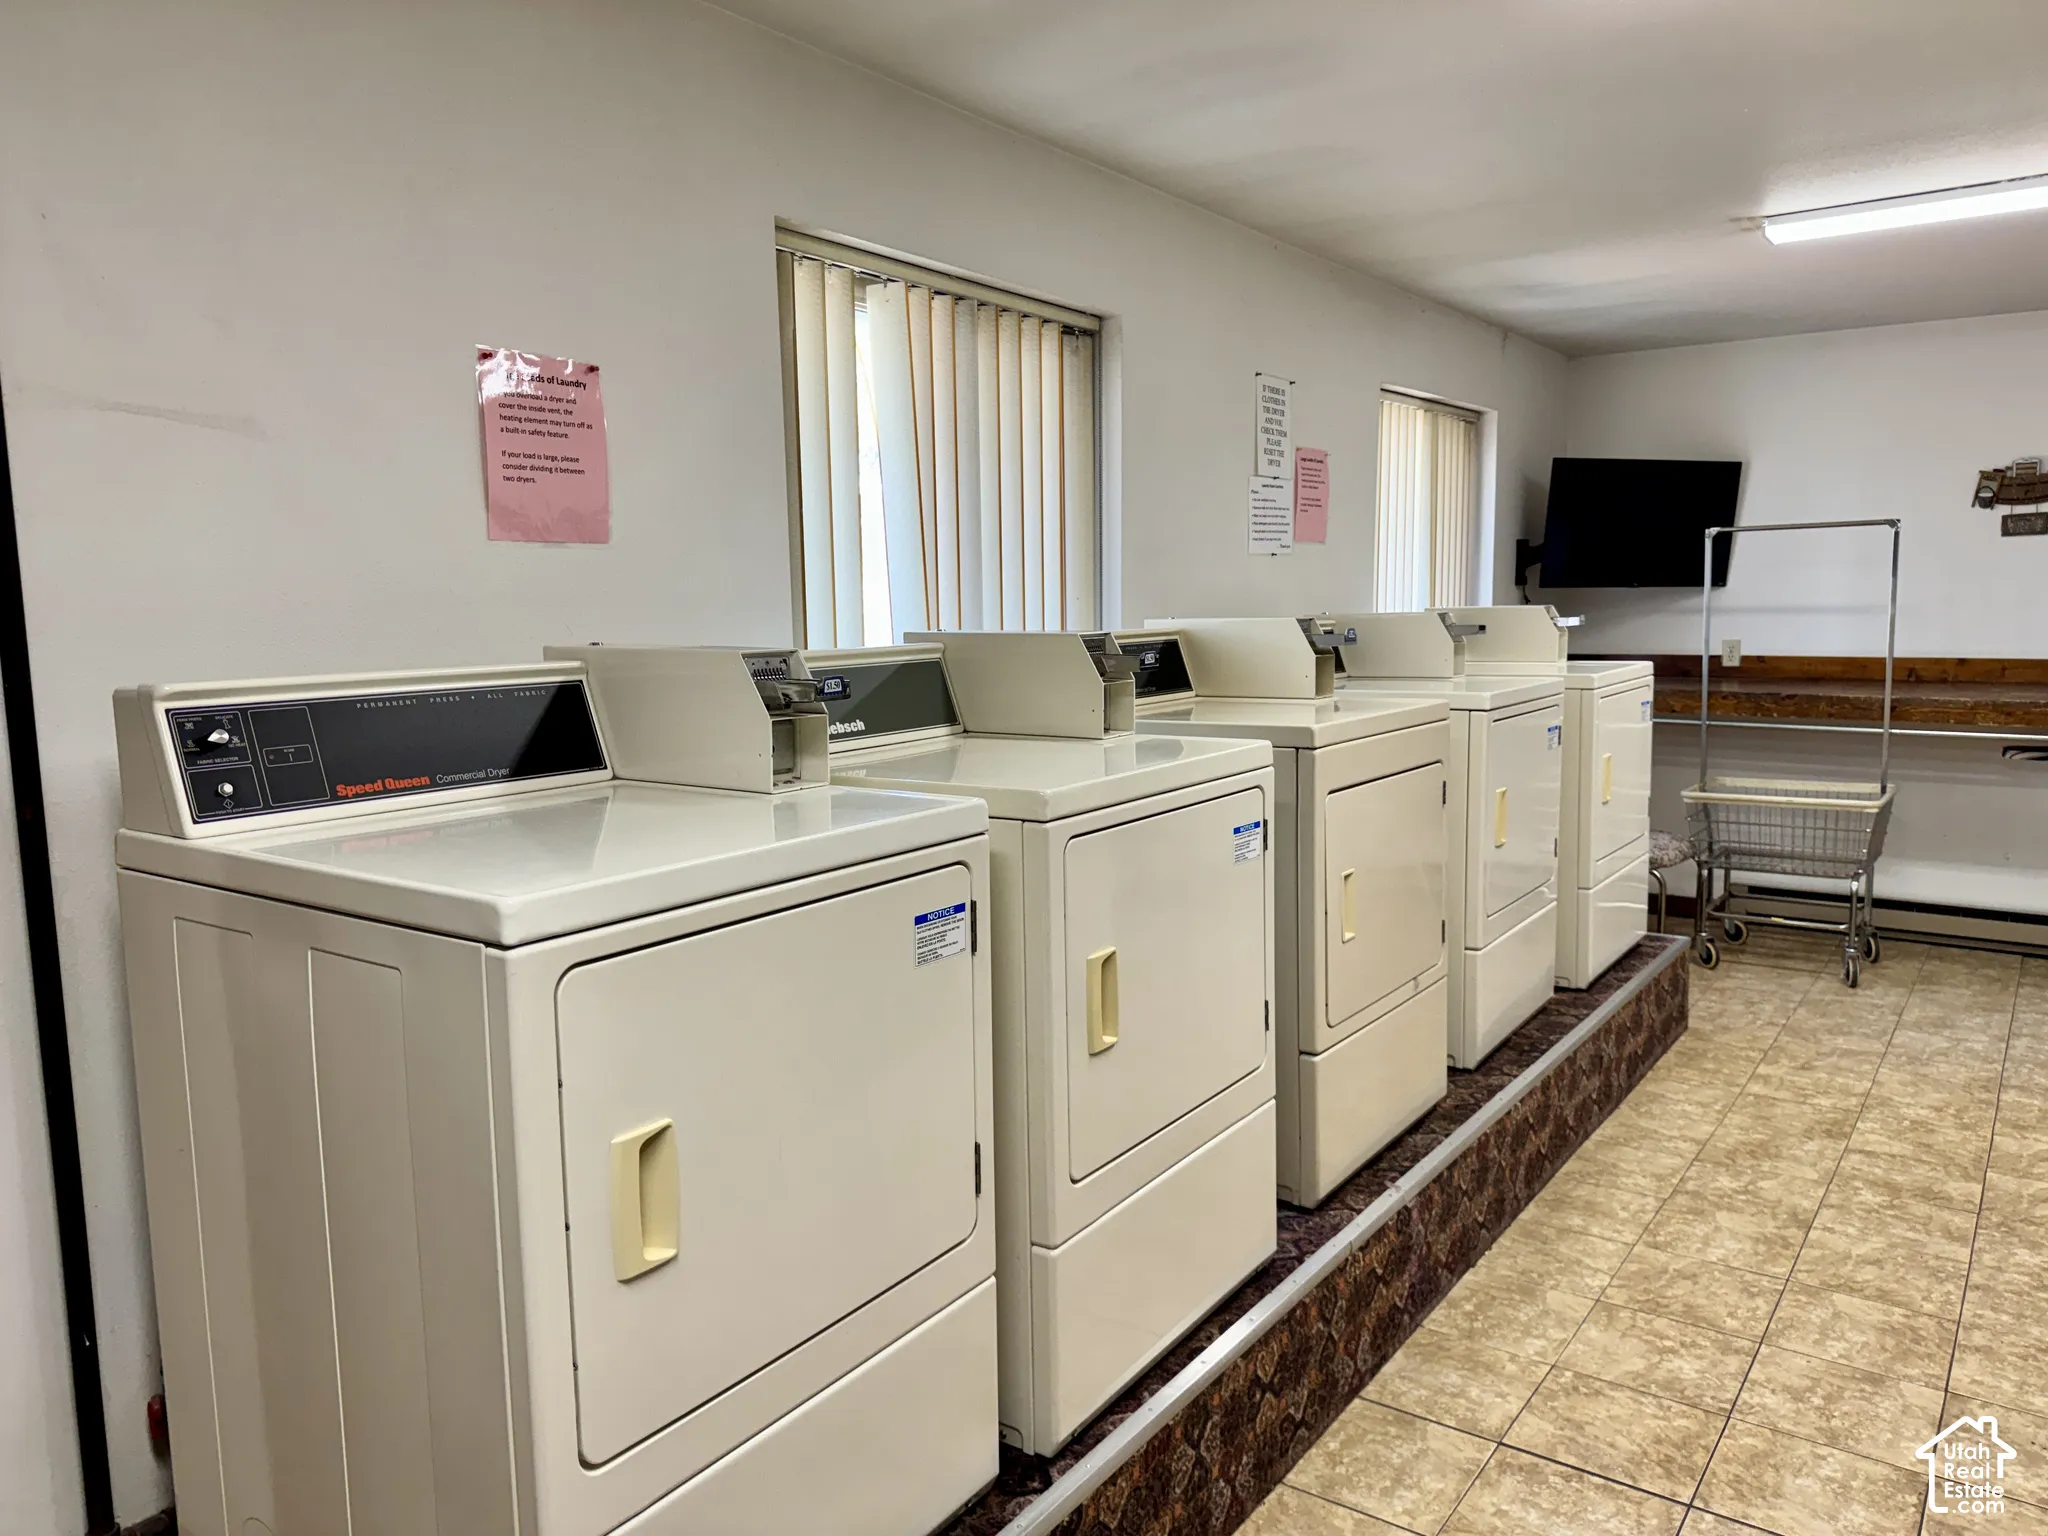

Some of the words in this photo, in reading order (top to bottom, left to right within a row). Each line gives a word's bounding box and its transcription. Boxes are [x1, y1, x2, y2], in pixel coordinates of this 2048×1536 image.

[547, 375, 555, 384] of
[556, 377, 587, 390] Laundry
[1267, 385, 1280, 396] THERE
[516, 392, 543, 401] overload
[549, 395, 564, 404] dryer
[1261, 395, 1280, 406] CLOTHES
[517, 403, 527, 411] the
[528, 405, 546, 413] inside
[1271, 407, 1285, 417] DRYER
[499, 413, 523, 424] heating
[523, 416, 548, 425] element
[549, 420, 562, 428] may
[563, 420, 576, 428] turn
[577, 421, 586, 429] off
[1264, 416, 1274, 425] AND
[505, 426, 527, 435] built-in
[528, 429, 546, 438] safety
[547, 430, 570, 439] feature.
[1260, 426, 1275, 436] CHECK
[1275, 428, 1288, 438] THEM
[1266, 437, 1282, 447] PLEASE
[507, 451, 521, 459] your
[522, 452, 536, 460] load
[543, 453, 560, 463] large,
[560, 455, 580, 463] please
[1267, 458, 1281, 468] DRYER
[502, 463, 528, 471] consider
[529, 464, 553, 474] dividing
[559, 466, 586, 475] between
[516, 475, 537, 484] dryers.
[825, 679, 841, 691] $1.50
[356, 698, 418, 709] PERMANENT
[429, 695, 461, 703] PRESS
[514, 689, 547, 697] FABRIC
[829, 719, 866, 735] ebsch
[214, 756, 239, 764] SELECTOR
[335, 779, 383, 798] Speed
[385, 775, 431, 790] Queen
[436, 769, 486, 784] Commercial
[488, 767, 510, 779] Dryer
[927, 906, 955, 921] NOTICE
